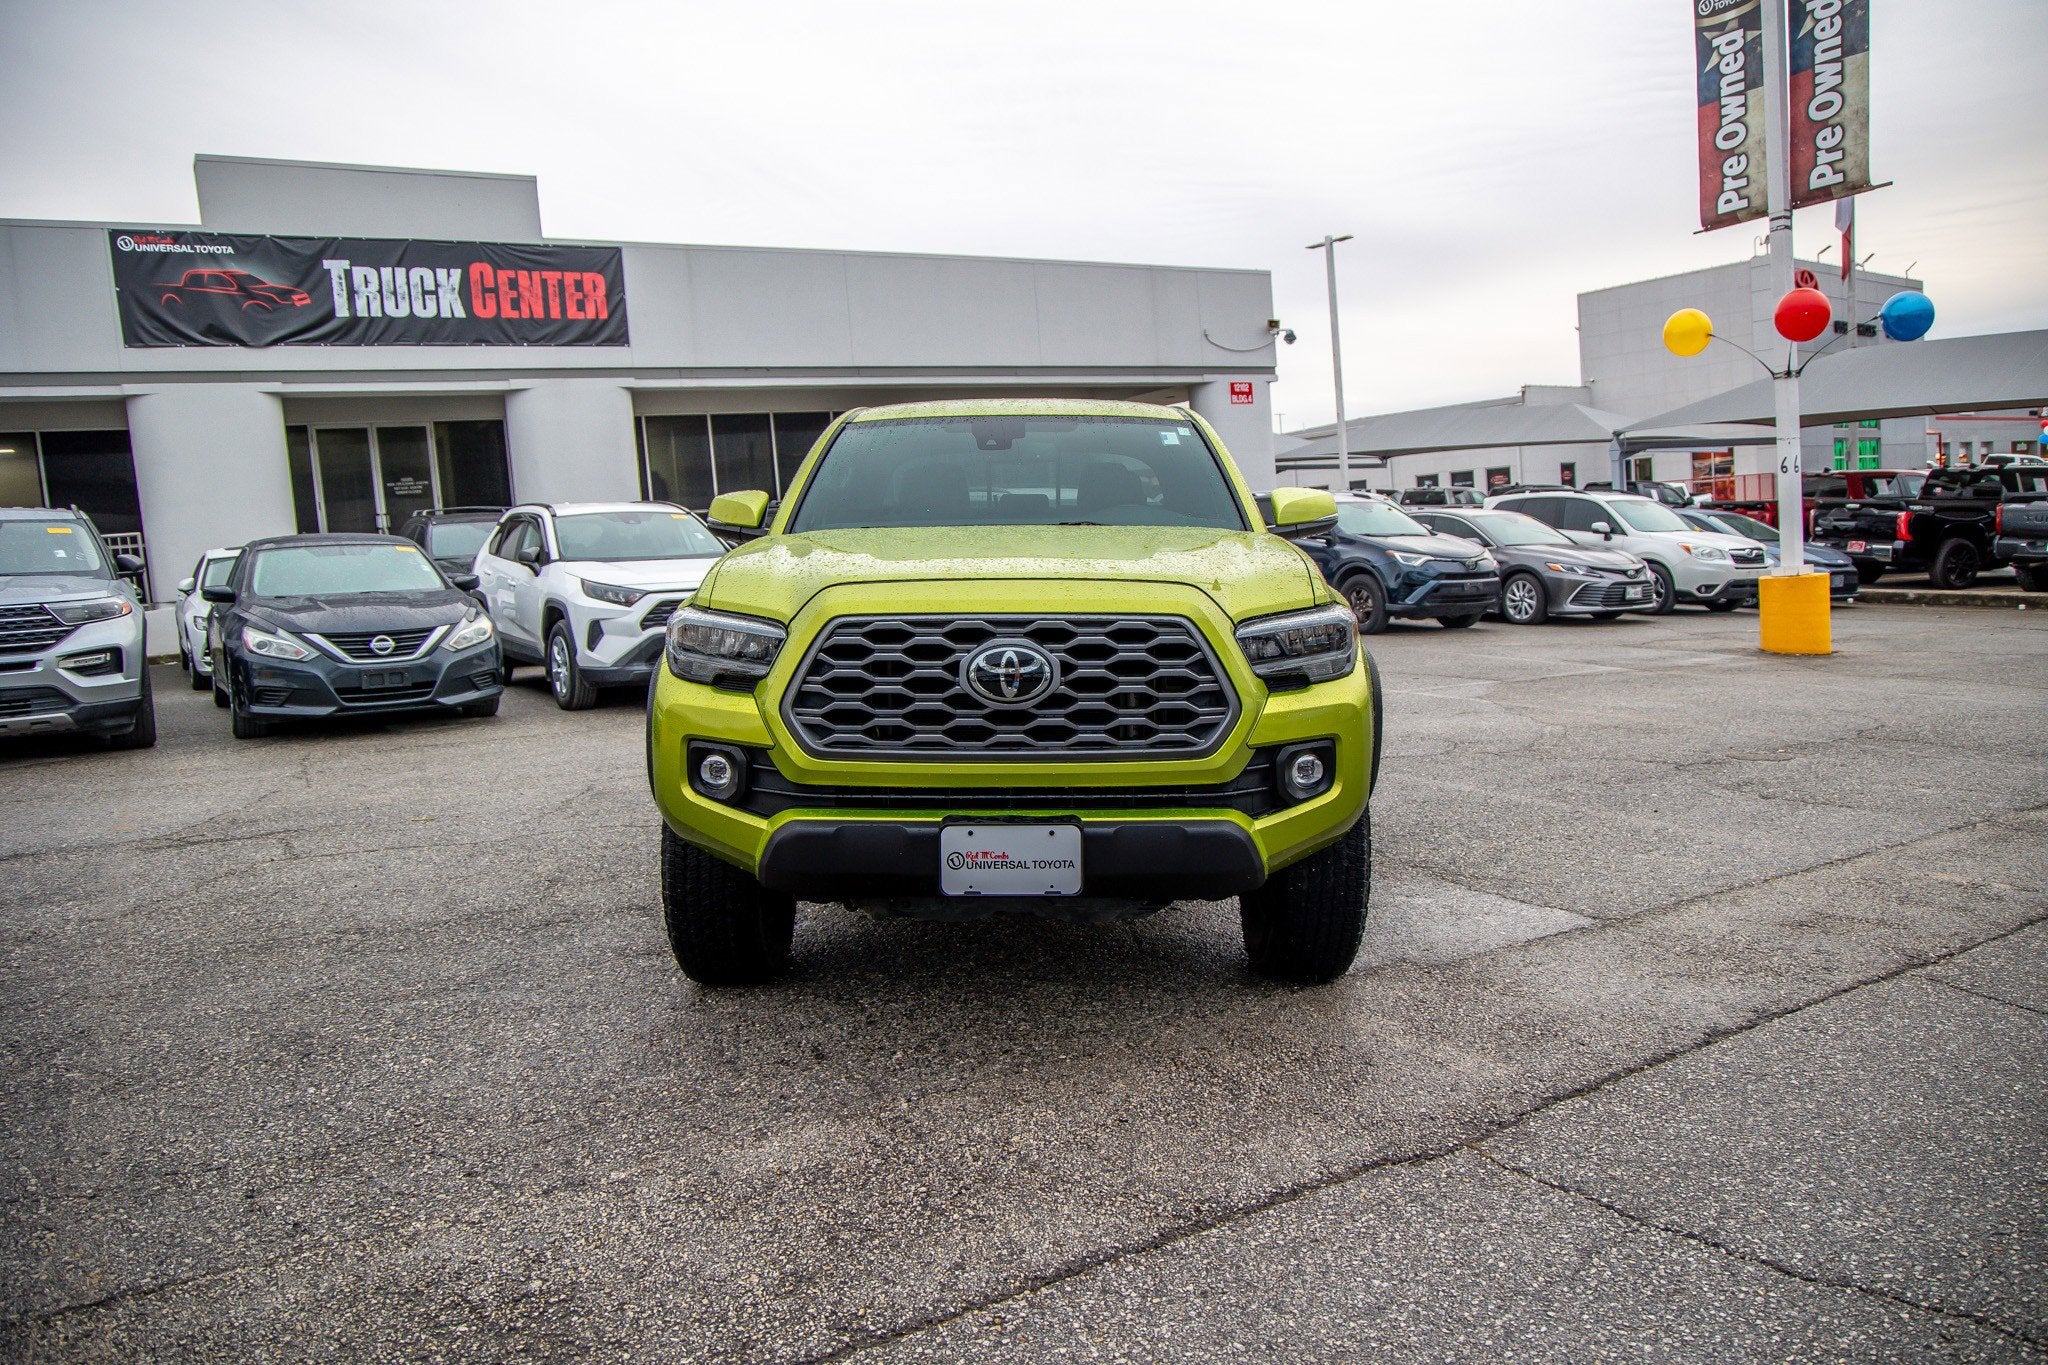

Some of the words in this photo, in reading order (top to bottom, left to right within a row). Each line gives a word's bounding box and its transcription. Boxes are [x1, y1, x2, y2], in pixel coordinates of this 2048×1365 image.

[1714, 0, 1741, 10] TOYO
[1711, 28, 1747, 150] Owned
[1806, 0, 1843, 121] Owned
[1717, 153, 1749, 214] Pre
[1809, 124, 1844, 190] Pre
[134, 243, 195, 253] UNIVERSAL
[195, 245, 235, 254] TOYOTA
[322, 259, 466, 318] TRUCK
[469, 262, 608, 319] CENTER
[966, 851, 979, 862] Red
[966, 860, 1030, 870] UNIVERSAL
[1032, 860, 1075, 869] TOYOTA
